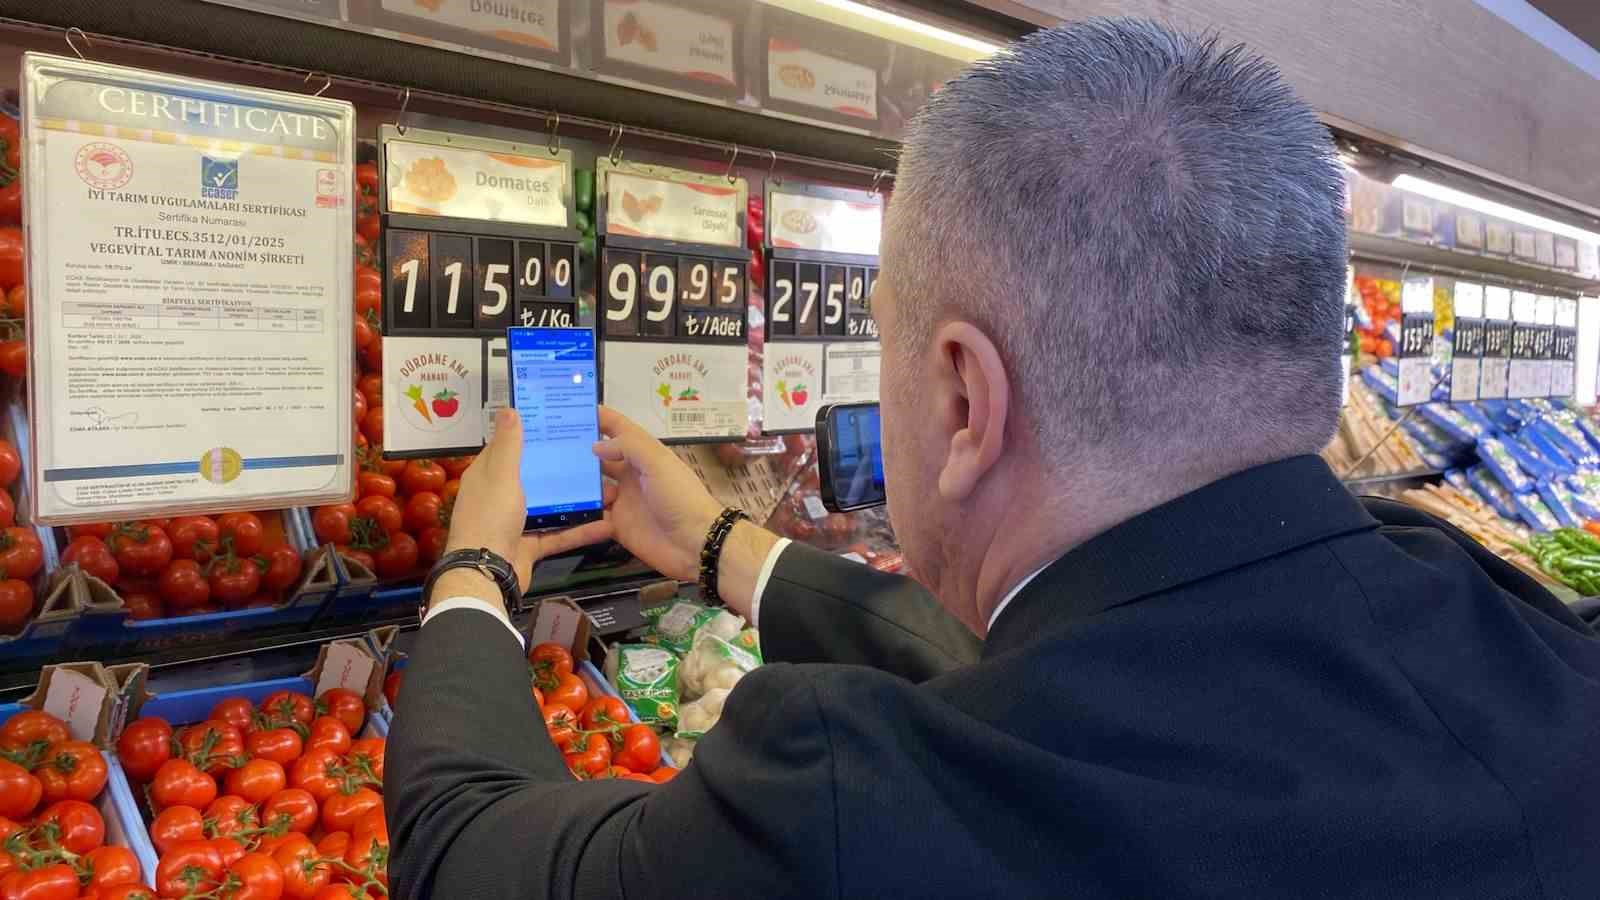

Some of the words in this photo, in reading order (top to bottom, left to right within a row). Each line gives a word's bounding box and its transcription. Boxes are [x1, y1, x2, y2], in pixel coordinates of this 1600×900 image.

[97, 88, 326, 141] CERTIFICATE
[475, 171, 550, 193] Domates
[88, 187, 105, 201] İYİ
[108, 191, 149, 205] TARIM
[151, 195, 240, 213] UYGULAMALARI
[242, 203, 307, 218] SERTİFİKASI
[158, 211, 199, 224] Sertifika
[201, 214, 247, 227] Numarası
[113, 224, 286, 249] TR.İTU.ECS.3512/01/2025
[90, 242, 164, 257] VEGEVİTAL
[165, 247, 207, 260] TARIM
[209, 250, 258, 262] ANONİM
[259, 252, 305, 266] ŞİRKETİ
[400, 352, 449, 378] DÜRDANE
[449, 359, 470, 379] ANA
